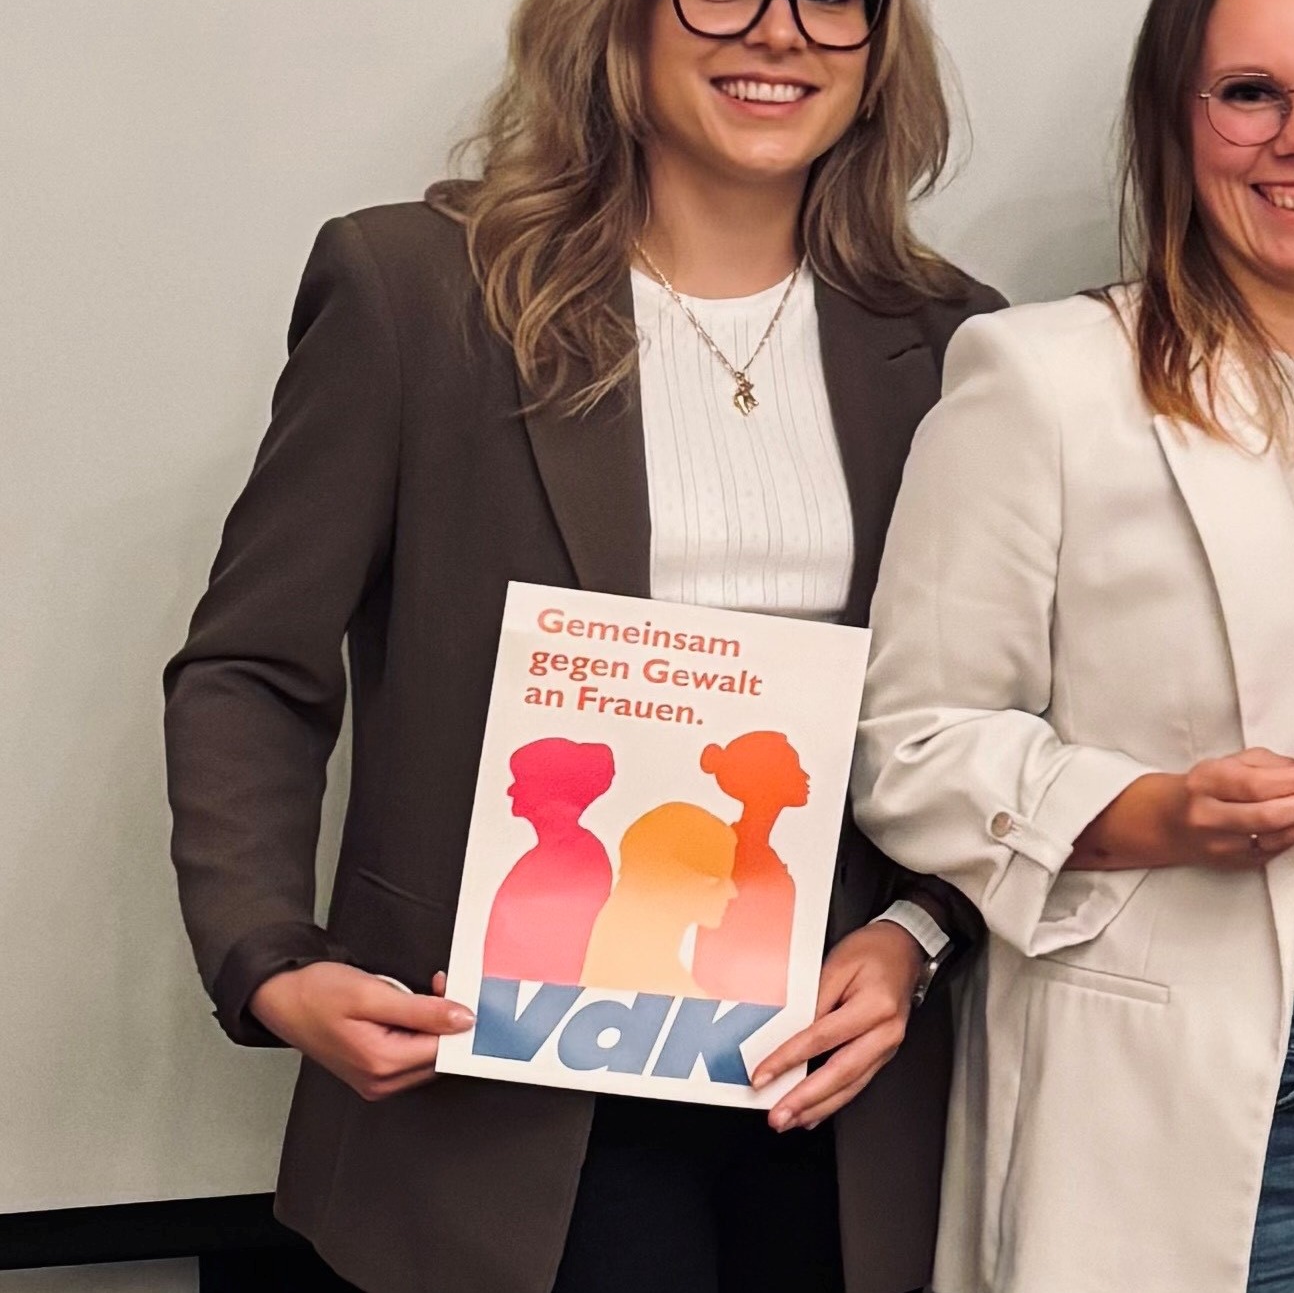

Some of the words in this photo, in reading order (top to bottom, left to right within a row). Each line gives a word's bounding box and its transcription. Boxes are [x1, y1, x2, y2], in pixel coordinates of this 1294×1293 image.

[537, 608, 741, 657] Gemeinsam
[529, 651, 630, 681] gegen
[643, 659, 763, 696] Gewalt
[524, 687, 564, 708] an
[577, 687, 704, 725] Frauen.
[472, 976, 787, 1086] VdK
